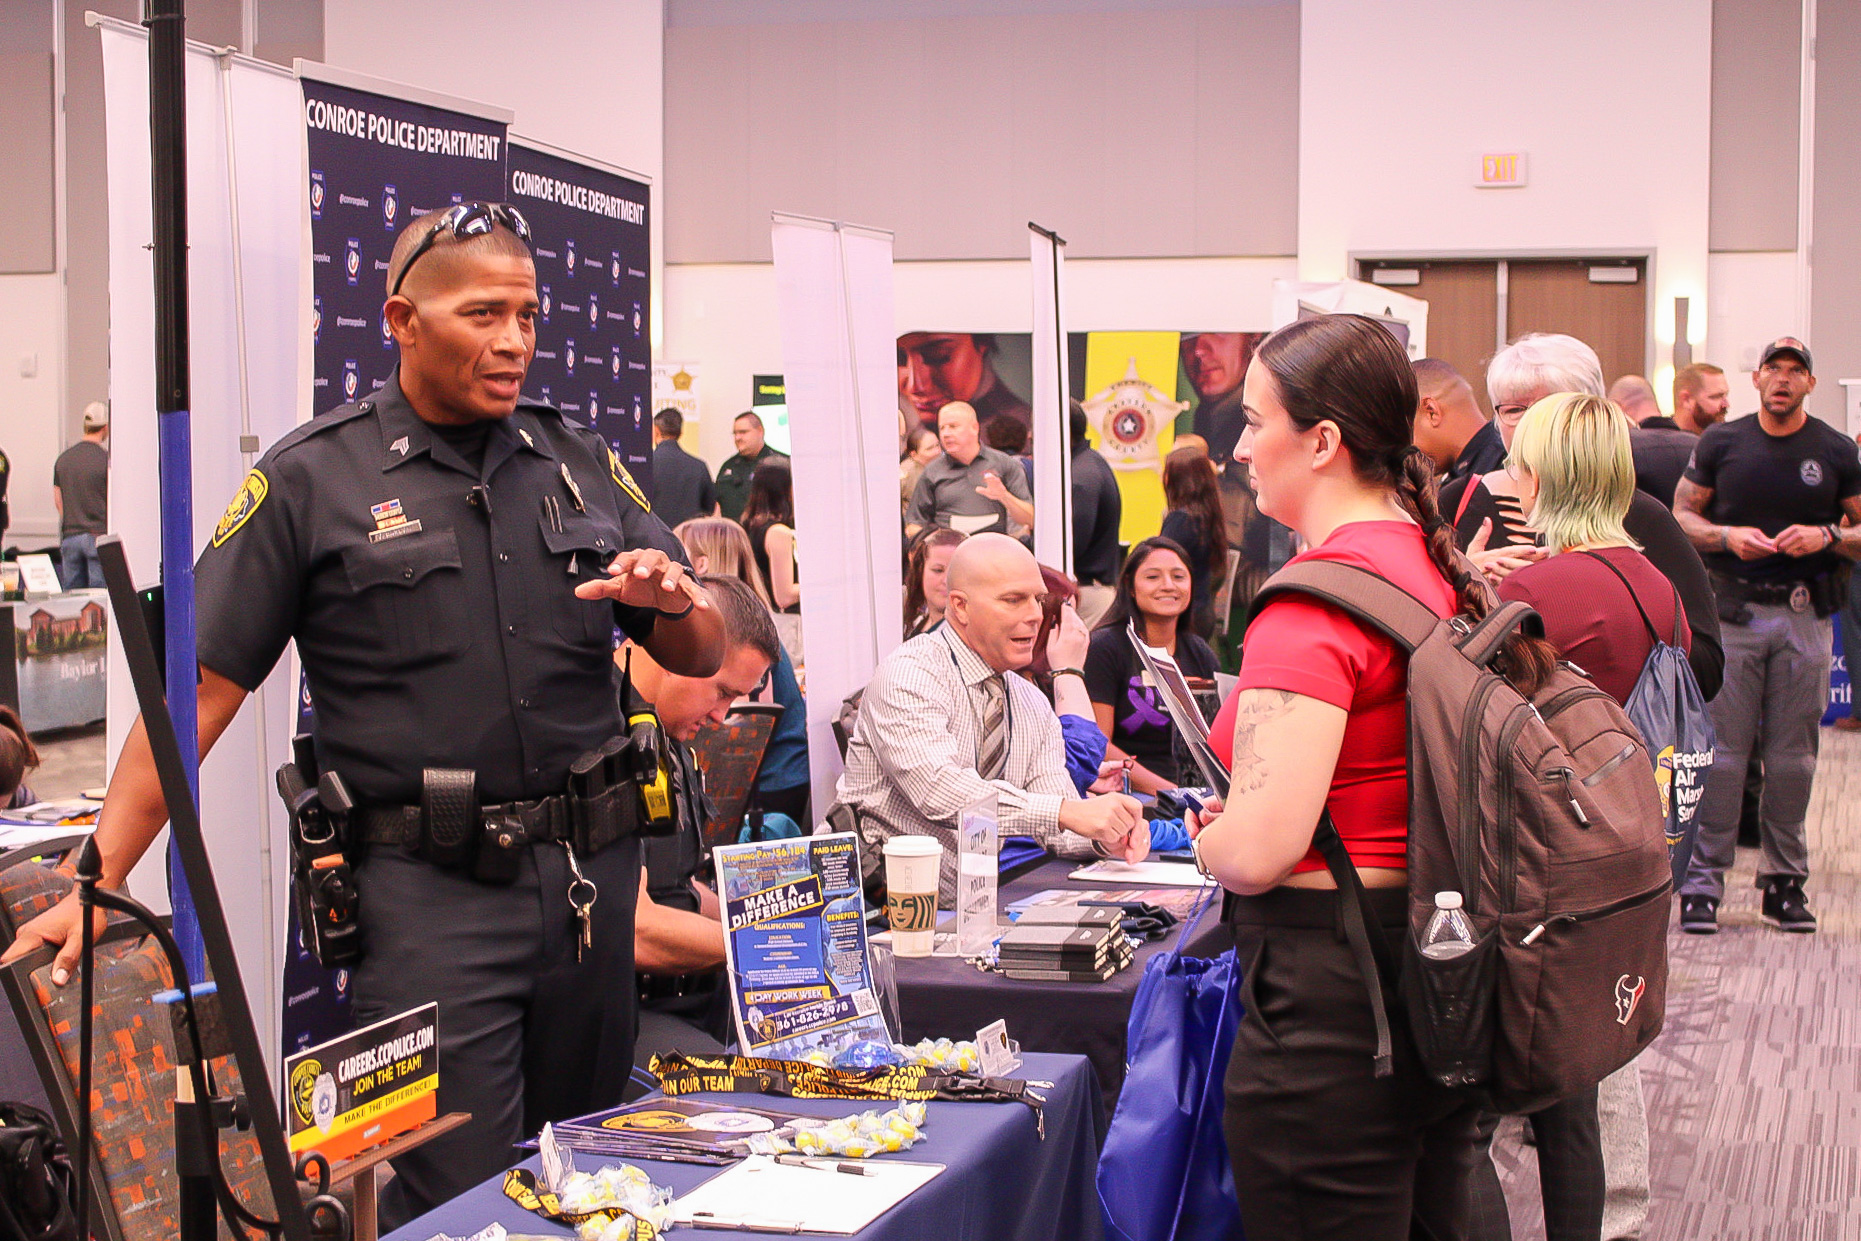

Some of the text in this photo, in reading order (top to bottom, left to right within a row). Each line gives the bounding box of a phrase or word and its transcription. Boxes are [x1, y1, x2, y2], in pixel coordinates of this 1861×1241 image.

[306, 99, 501, 162] CONROE POLICE DEPARTMENT
[1483, 154, 1518, 181] EXIT
[512, 170, 645, 226] CONROE POLICE DEPARTMENT
[60, 659, 98, 681] Baylor
[1672, 747, 1715, 770] Federal
[1675, 768, 1697, 787] Air
[813, 847, 831, 856] PAID
[731, 891, 815, 929] DIFFERENCE
[744, 883, 799, 912] MAKE A
[773, 990, 799, 1001] WORK
[799, 989, 823, 999] WEEK
[337, 1024, 435, 1084] CAREERS.CCPOLICE.COM
[353, 1053, 422, 1097] JOIN THE TEAM!
[680, 1076, 701, 1094] OUR
[702, 1075, 735, 1093] TEAM
[344, 1078, 432, 1125] MAKE THE DIFFERENCE!
